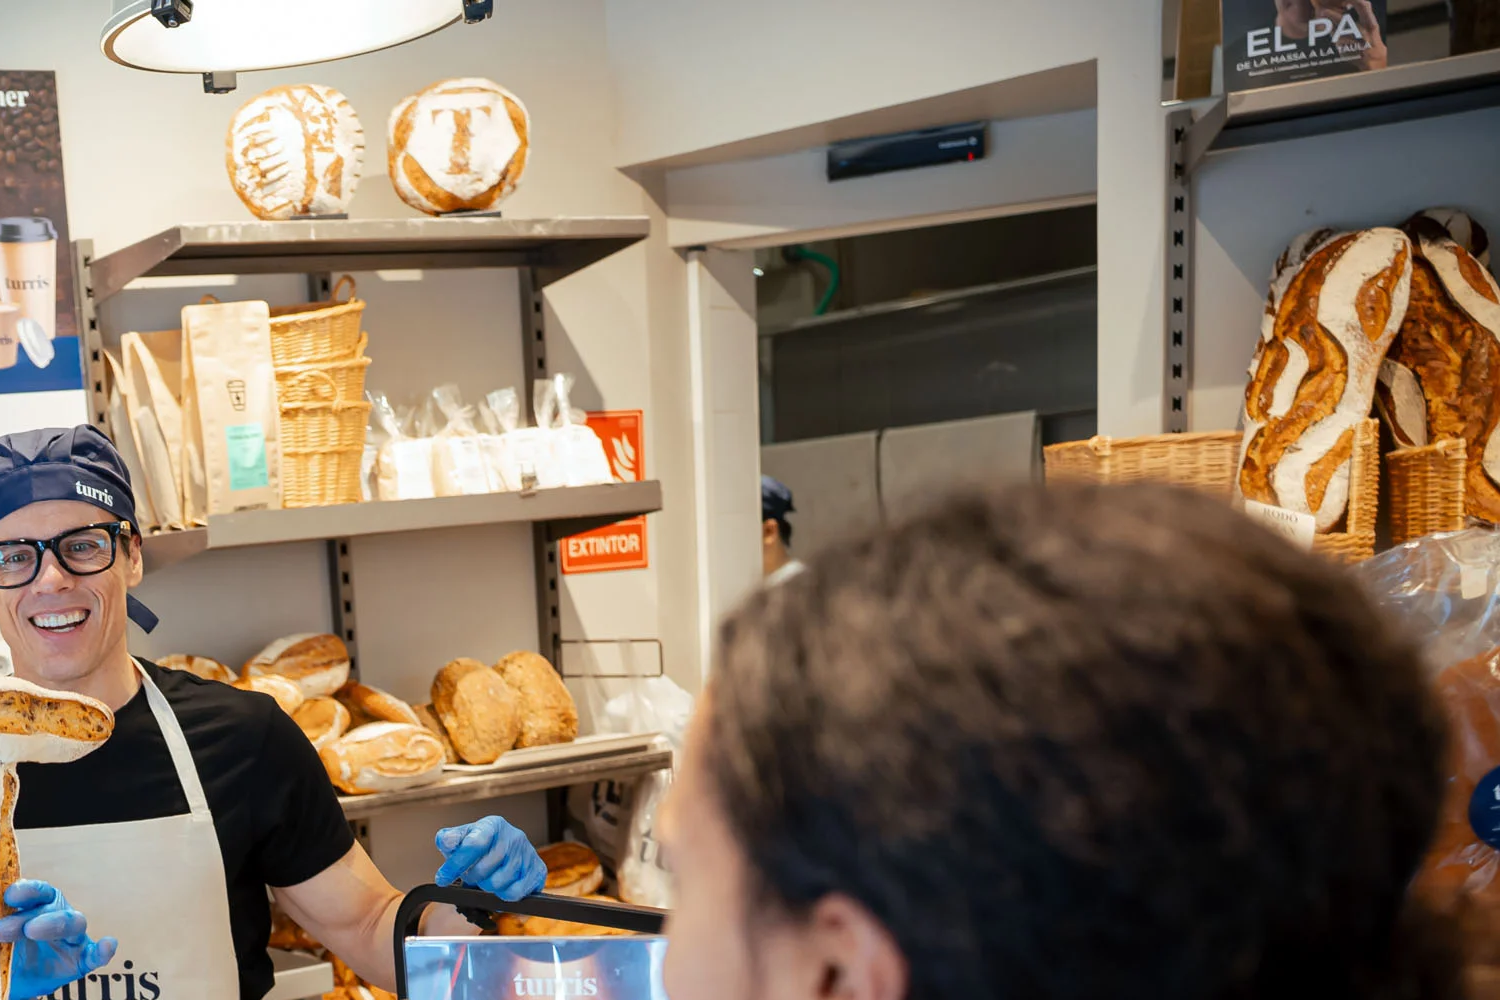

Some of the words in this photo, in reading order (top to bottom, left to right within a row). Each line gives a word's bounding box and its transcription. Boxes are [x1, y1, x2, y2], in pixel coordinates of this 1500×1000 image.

[1247, 26, 1297, 57] EL
[1236, 61, 1250, 71] DE
[1253, 59, 1268, 68] LA
[1270, 51, 1306, 65] MASSA
[1309, 50, 1318, 59] A
[1320, 47, 1335, 57] LA
[1336, 41, 1372, 53] TAULA
[5, 274, 50, 290] turris
[75, 480, 114, 507] turris
[568, 534, 640, 558] EXTINTOR
